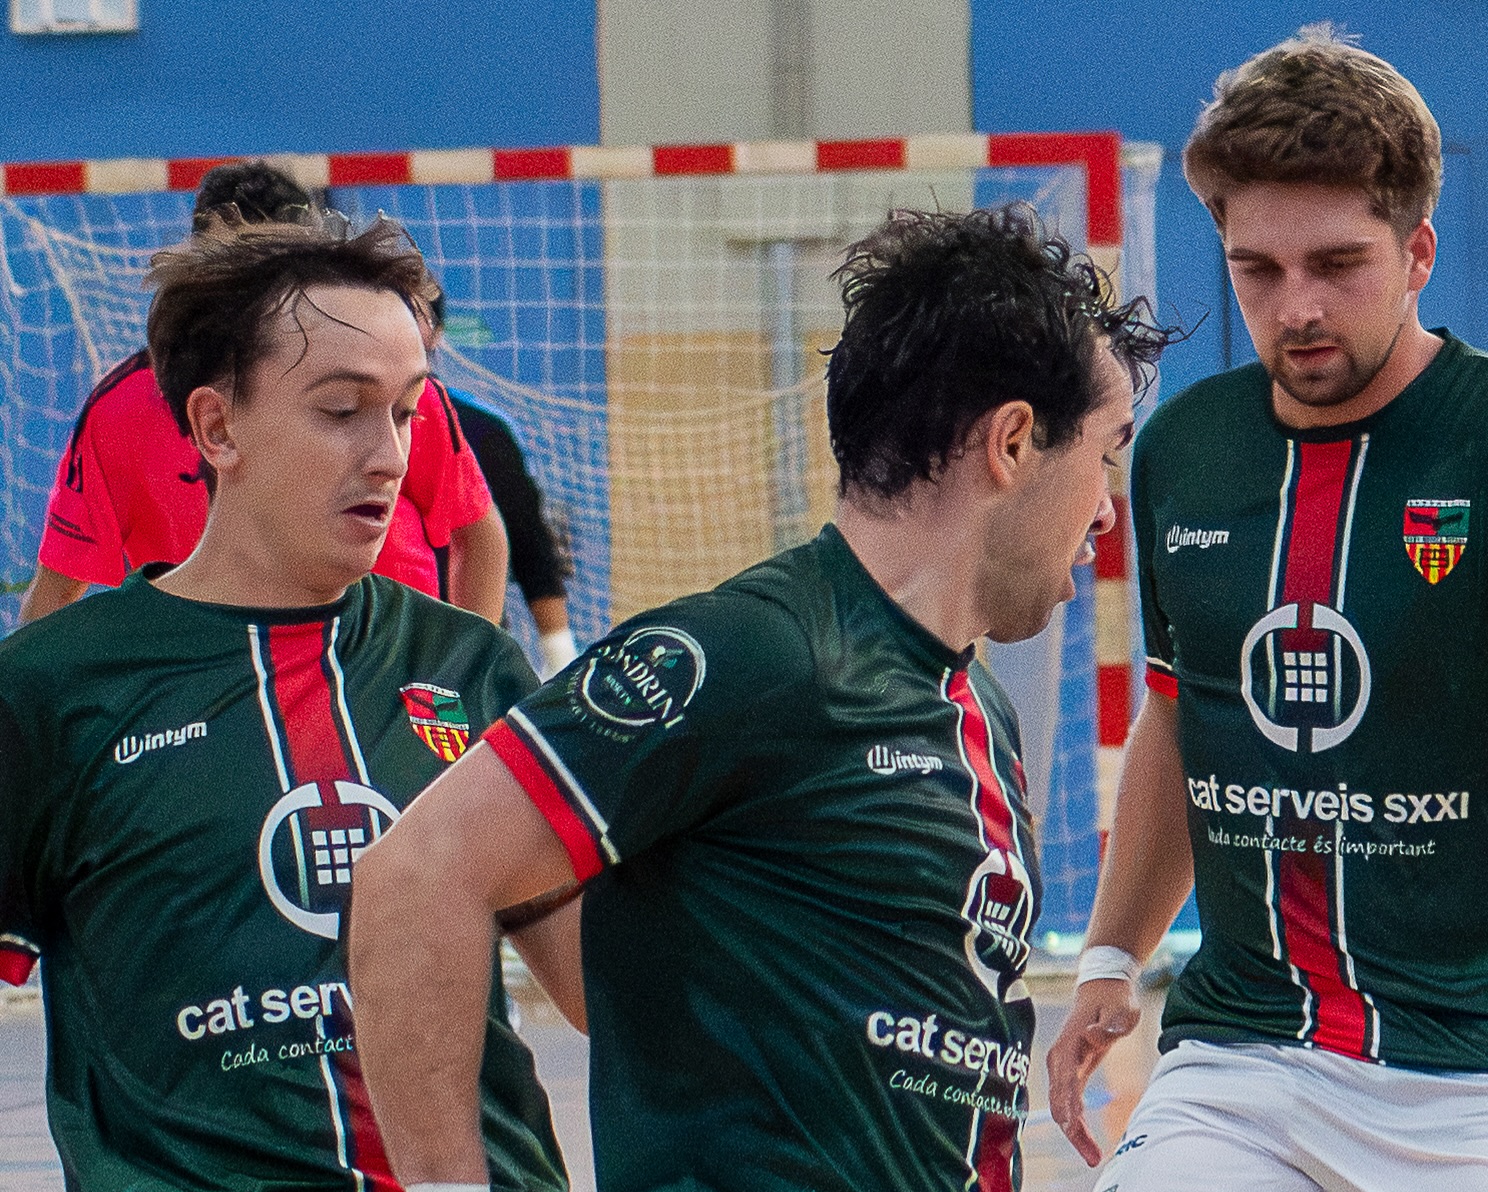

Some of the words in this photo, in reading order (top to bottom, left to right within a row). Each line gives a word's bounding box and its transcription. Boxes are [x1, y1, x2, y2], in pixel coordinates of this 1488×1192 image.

[1224, 782, 1375, 823] serveis
[1233, 833, 1307, 853] contacte
[1340, 835, 1437, 861] important
[177, 985, 254, 1041] cat
[867, 1011, 939, 1058] cat
[221, 1043, 270, 1072] Cada
[889, 1069, 938, 1098] Cada
